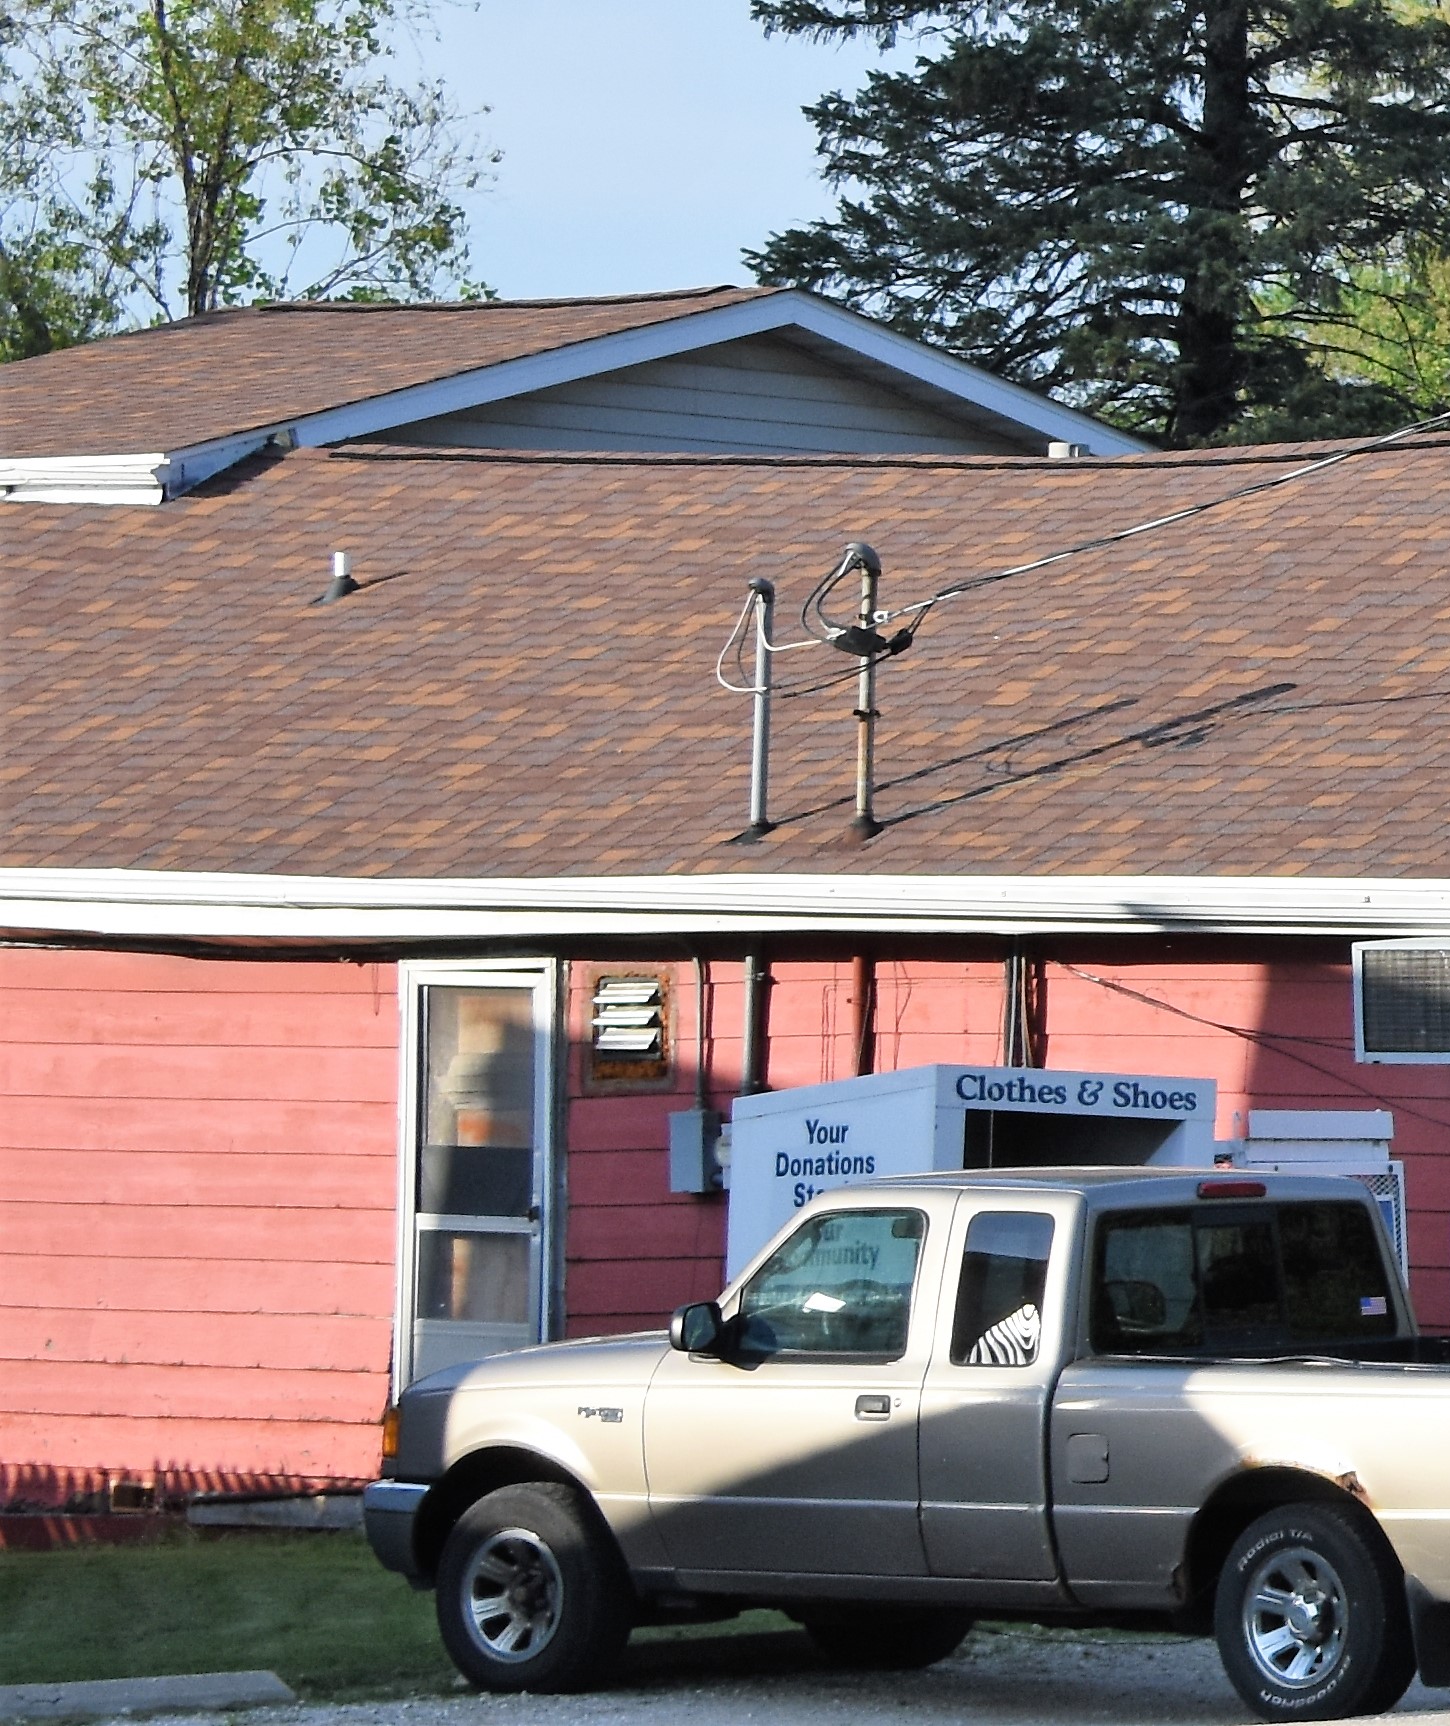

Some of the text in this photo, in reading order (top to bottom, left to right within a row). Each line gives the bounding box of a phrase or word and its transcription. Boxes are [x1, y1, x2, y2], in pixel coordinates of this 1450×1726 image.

[956, 1073, 1197, 1111] Clothes & Shoes
[805, 1119, 850, 1144] Your
[775, 1150, 876, 1177] Donations
